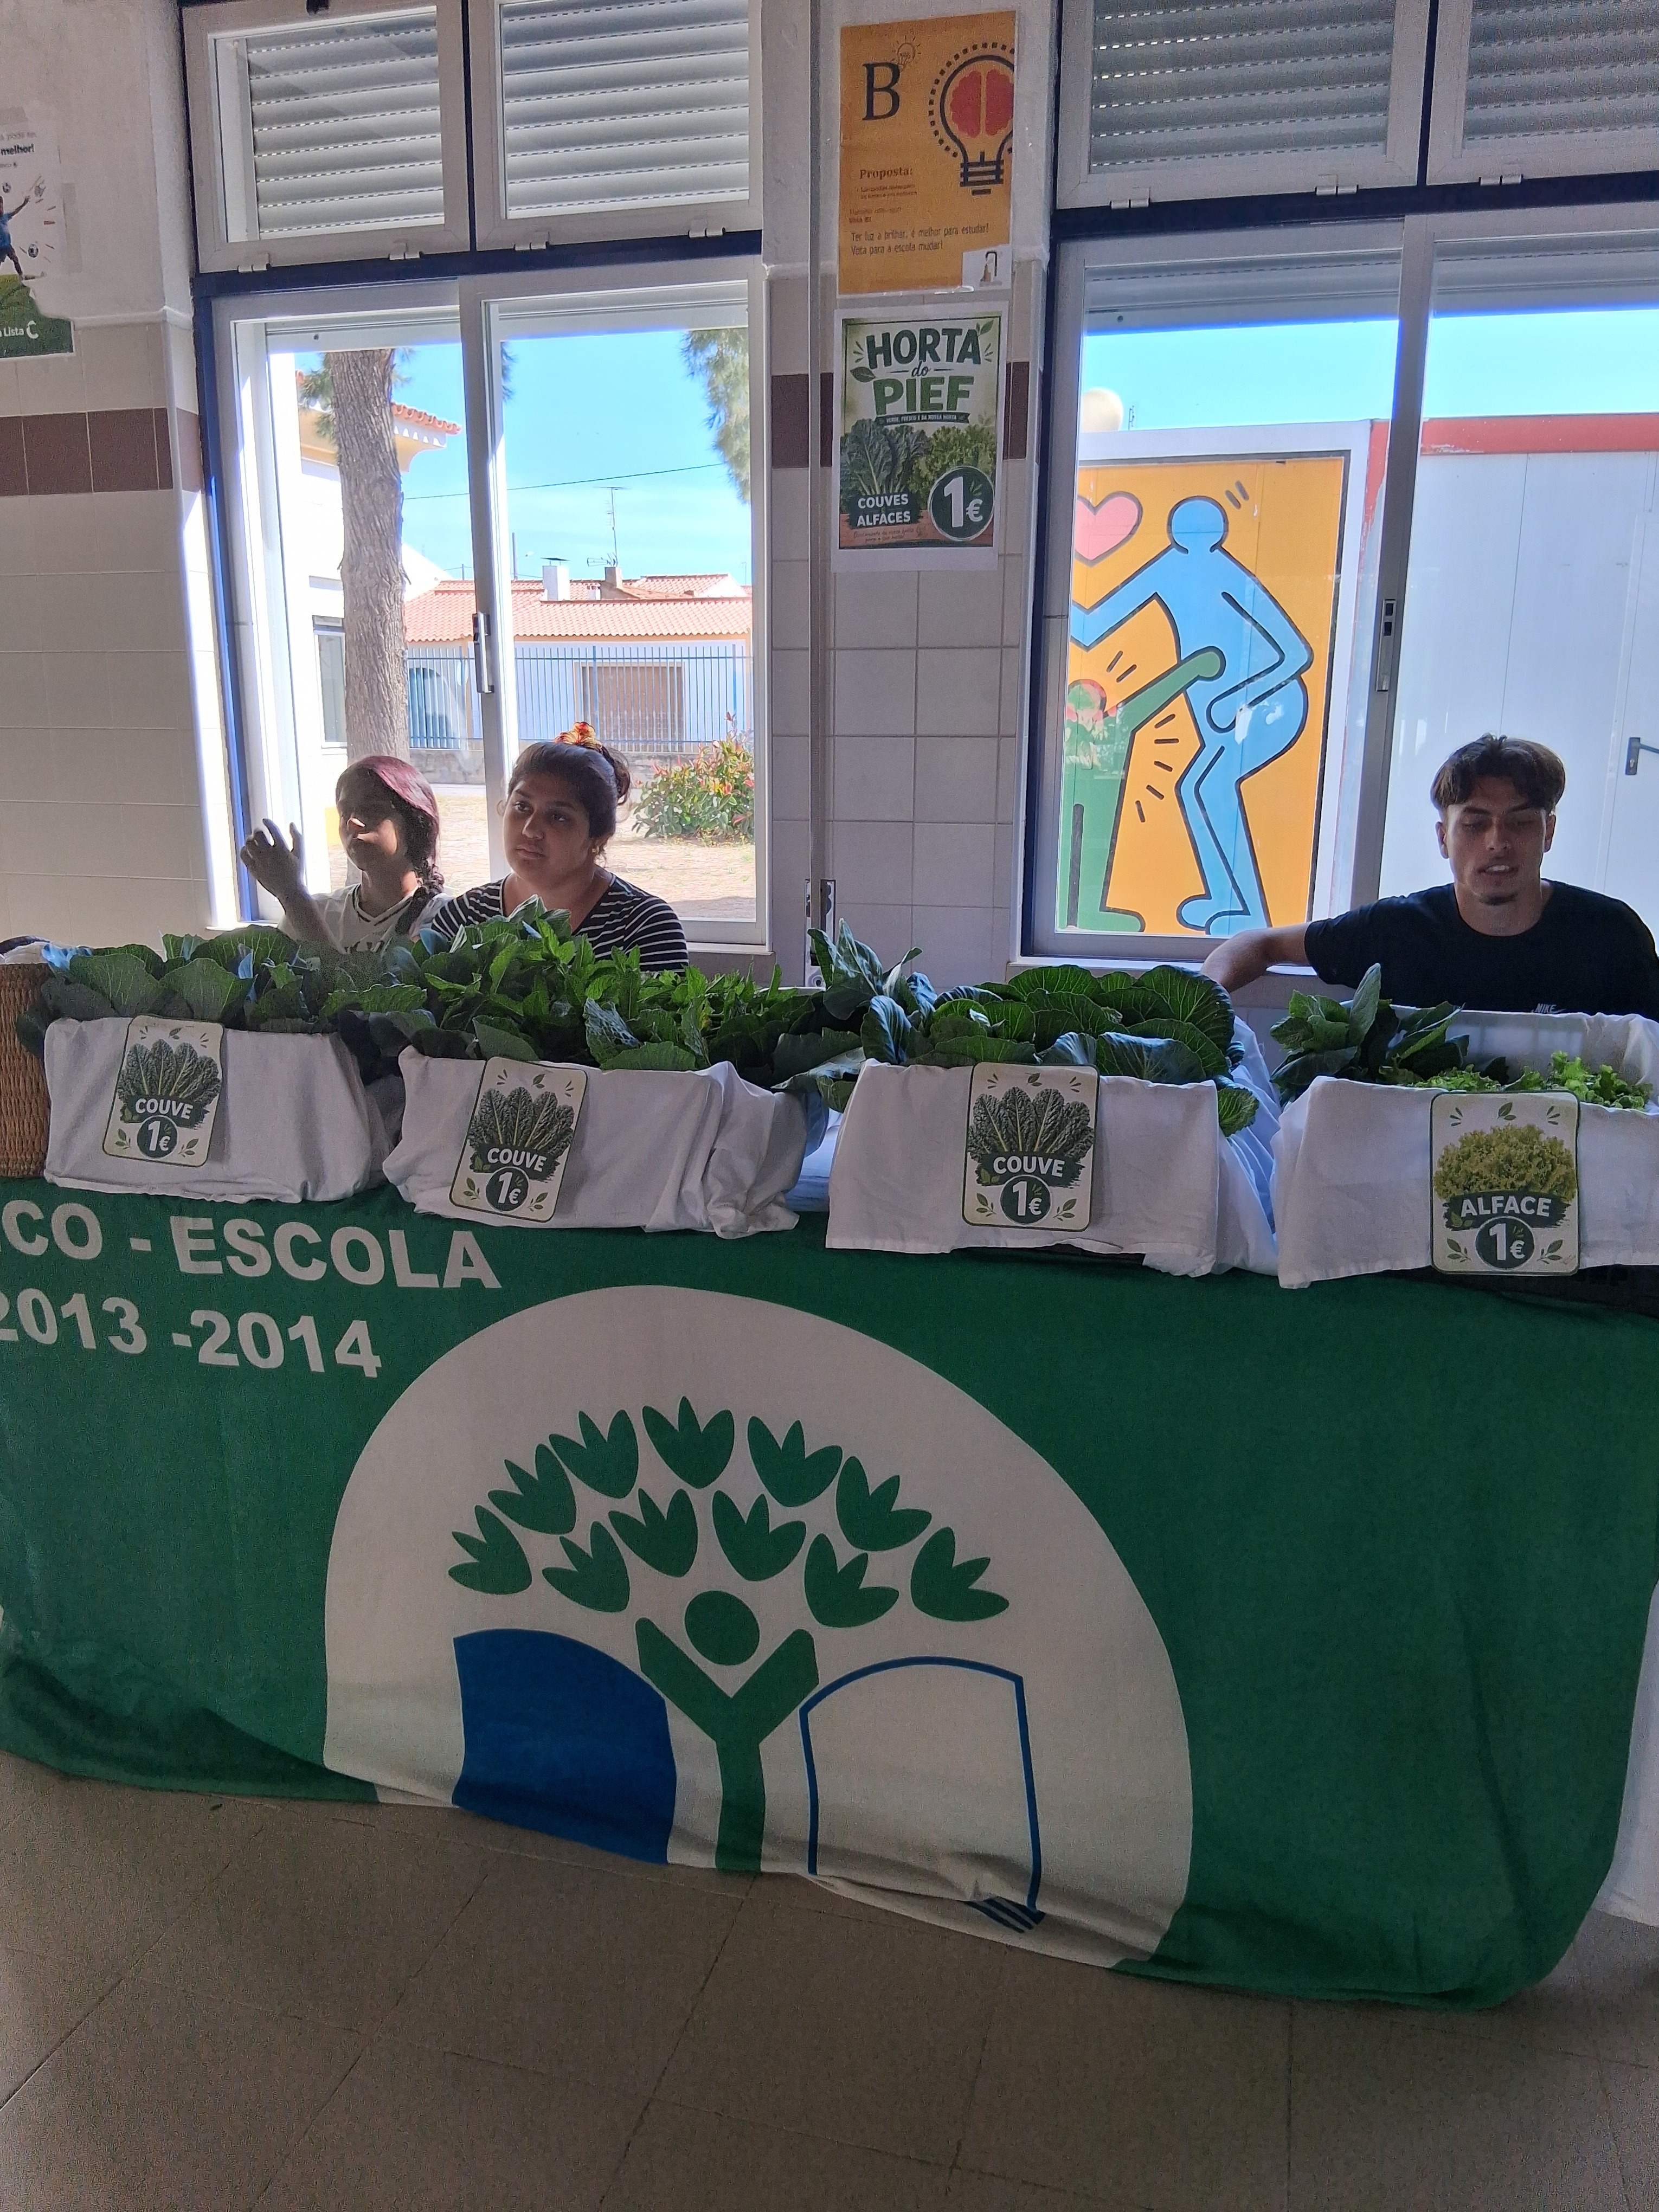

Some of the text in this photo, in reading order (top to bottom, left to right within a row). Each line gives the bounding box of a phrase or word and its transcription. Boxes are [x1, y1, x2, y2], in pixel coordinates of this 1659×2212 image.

[862, 62, 901, 121] B
[859, 167, 912, 180] Proposta:
[944, 228, 959, 237] para
[962, 222, 989, 234] estudar!
[869, 245, 885, 256] para
[4, 326, 24, 337] Lista
[26, 320, 39, 339] C
[866, 327, 982, 370] HORTA
[911, 361, 931, 378] do
[872, 376, 975, 416] PIEF
[858, 493, 909, 509] COUVES
[943, 476, 983, 528] 1€
[857, 511, 911, 528] ALFACES
[1534, 1003, 1557, 1014] NIKE
[136, 1098, 193, 1120] COUVE
[147, 1120, 171, 1152] 1€
[487, 1148, 547, 1172] COUVE
[993, 1155, 1065, 1178] COUVE
[498, 1172, 522, 1204] 1€
[1012, 1180, 1043, 1216] 1€
[1461, 1195, 1552, 1218] ALFACE
[0, 1199, 104, 1261] CO
[170, 1215, 502, 1289] ESCOLA
[1489, 1223, 1526, 1261] 1€
